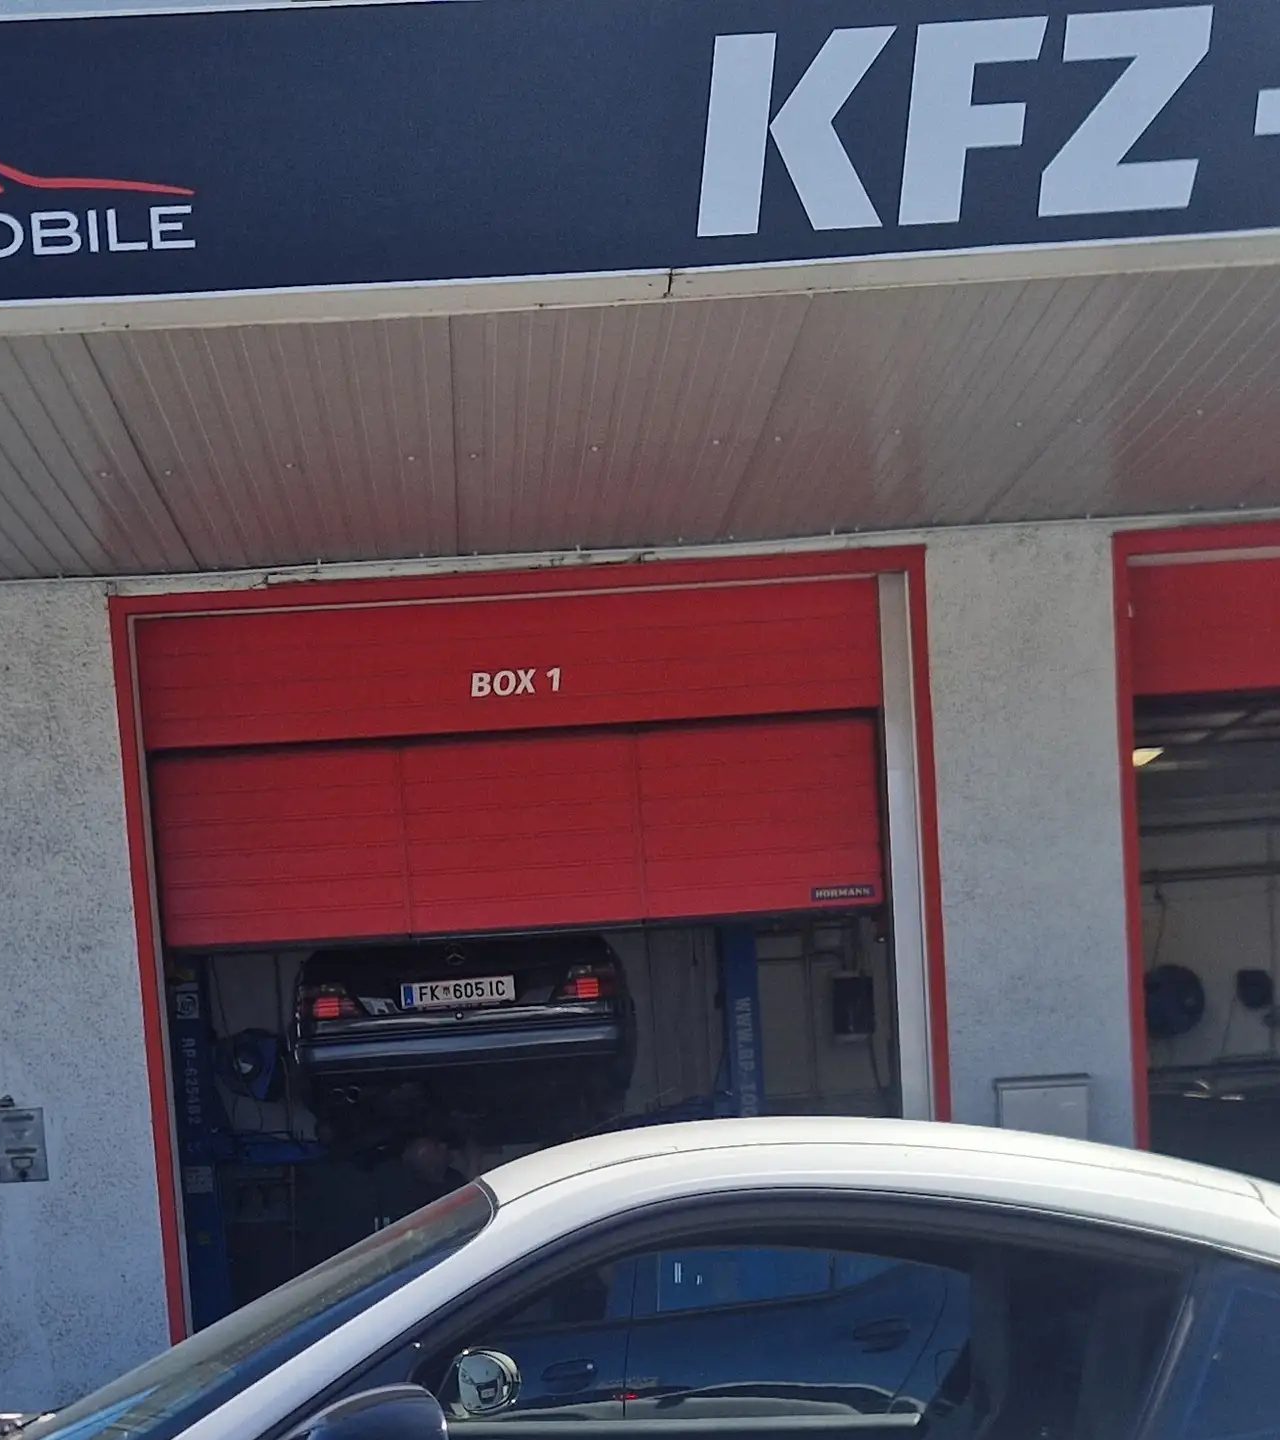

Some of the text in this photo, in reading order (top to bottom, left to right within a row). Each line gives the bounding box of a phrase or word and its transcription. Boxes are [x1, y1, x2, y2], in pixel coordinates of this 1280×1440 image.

[471, 667, 561, 697] BOX 1
[419, 984, 440, 1002] FK
[453, 981, 485, 999] 605
